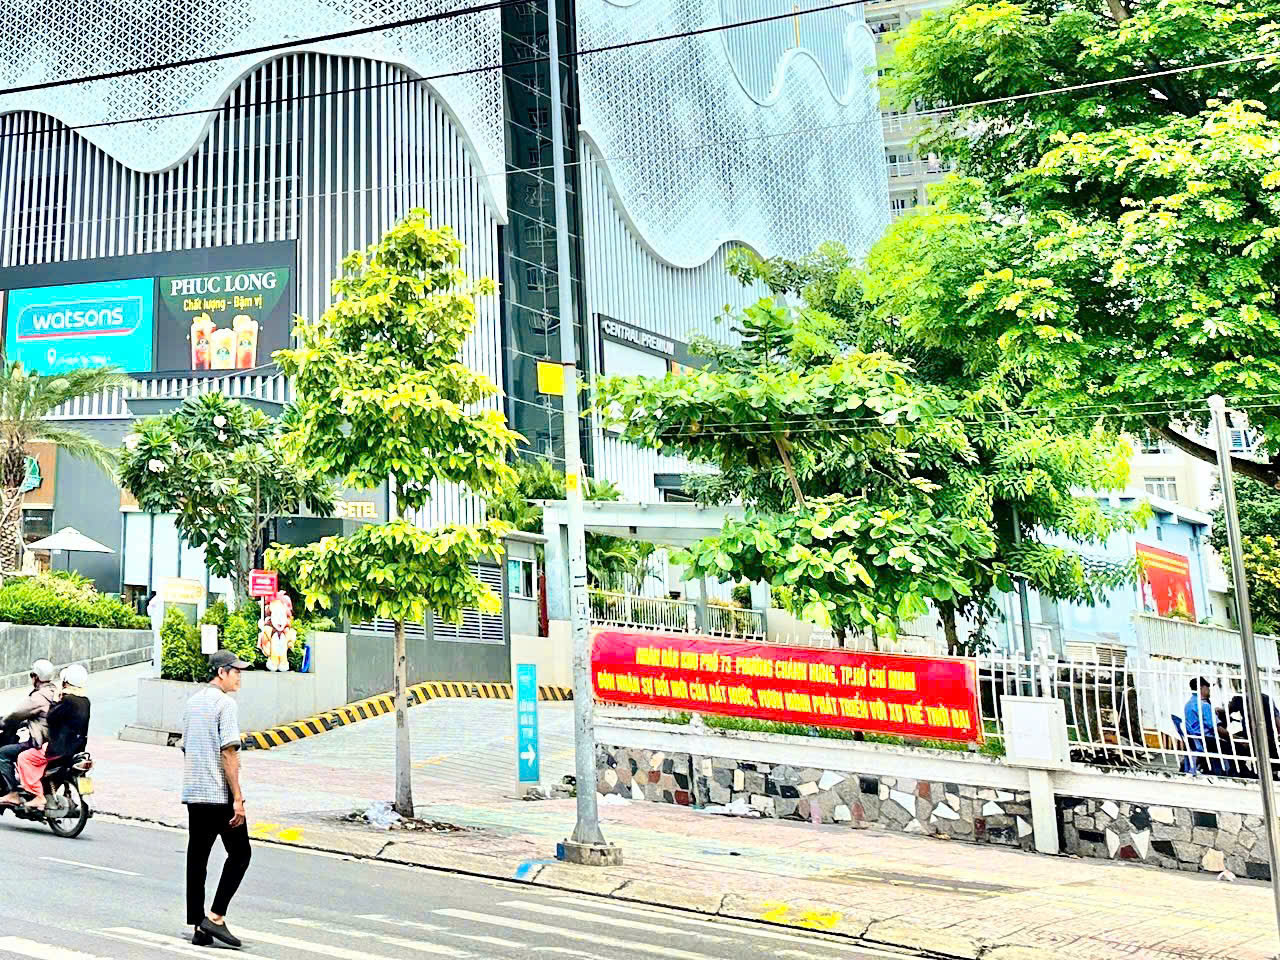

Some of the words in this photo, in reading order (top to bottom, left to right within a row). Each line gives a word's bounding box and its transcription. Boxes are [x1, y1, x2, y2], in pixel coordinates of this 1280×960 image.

[170, 276, 221, 296] PHUC
[224, 272, 277, 292] LONG
[32, 307, 124, 330] watsons
[603, 320, 641, 343] CENTRAL
[642, 333, 674, 355] PREMIUM
